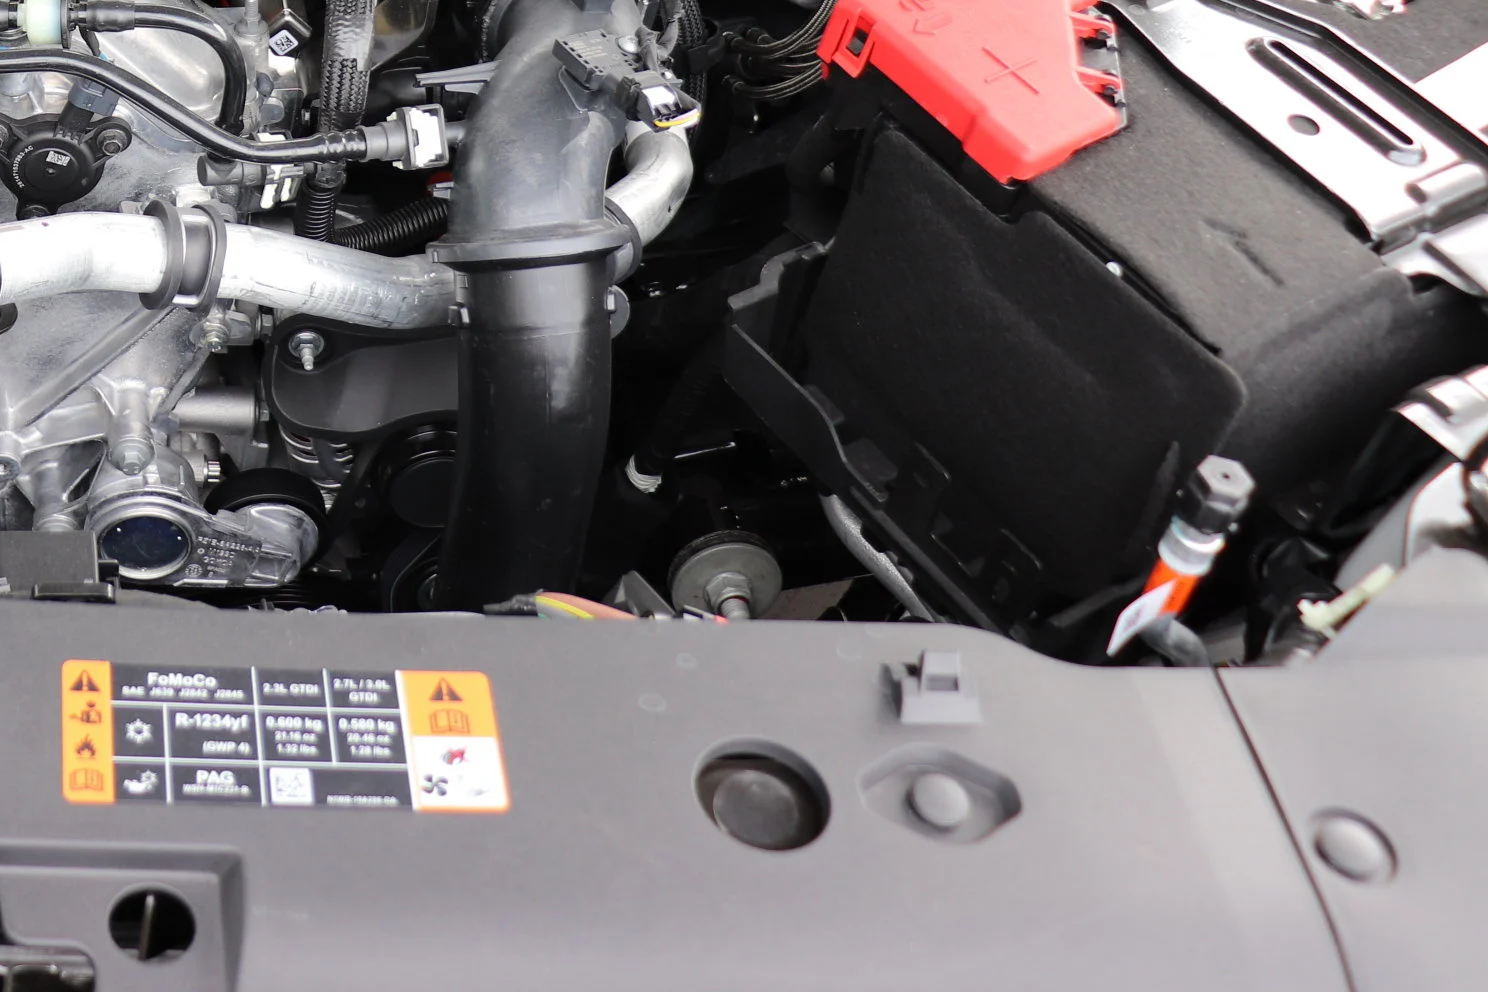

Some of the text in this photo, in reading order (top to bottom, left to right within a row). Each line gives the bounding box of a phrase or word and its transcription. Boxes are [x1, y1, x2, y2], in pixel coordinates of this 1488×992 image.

[147, 672, 218, 688] FoMoCo
[121, 685, 145, 696] SAE
[262, 682, 320, 695] 2.3L GTDI
[348, 692, 379, 703] GTDI
[175, 712, 250, 733] R-1234yf
[265, 715, 324, 732] 0.600 kg
[376, 719, 398, 734] kg
[202, 740, 237, 754] (GWP
[195, 769, 237, 785] PAG
